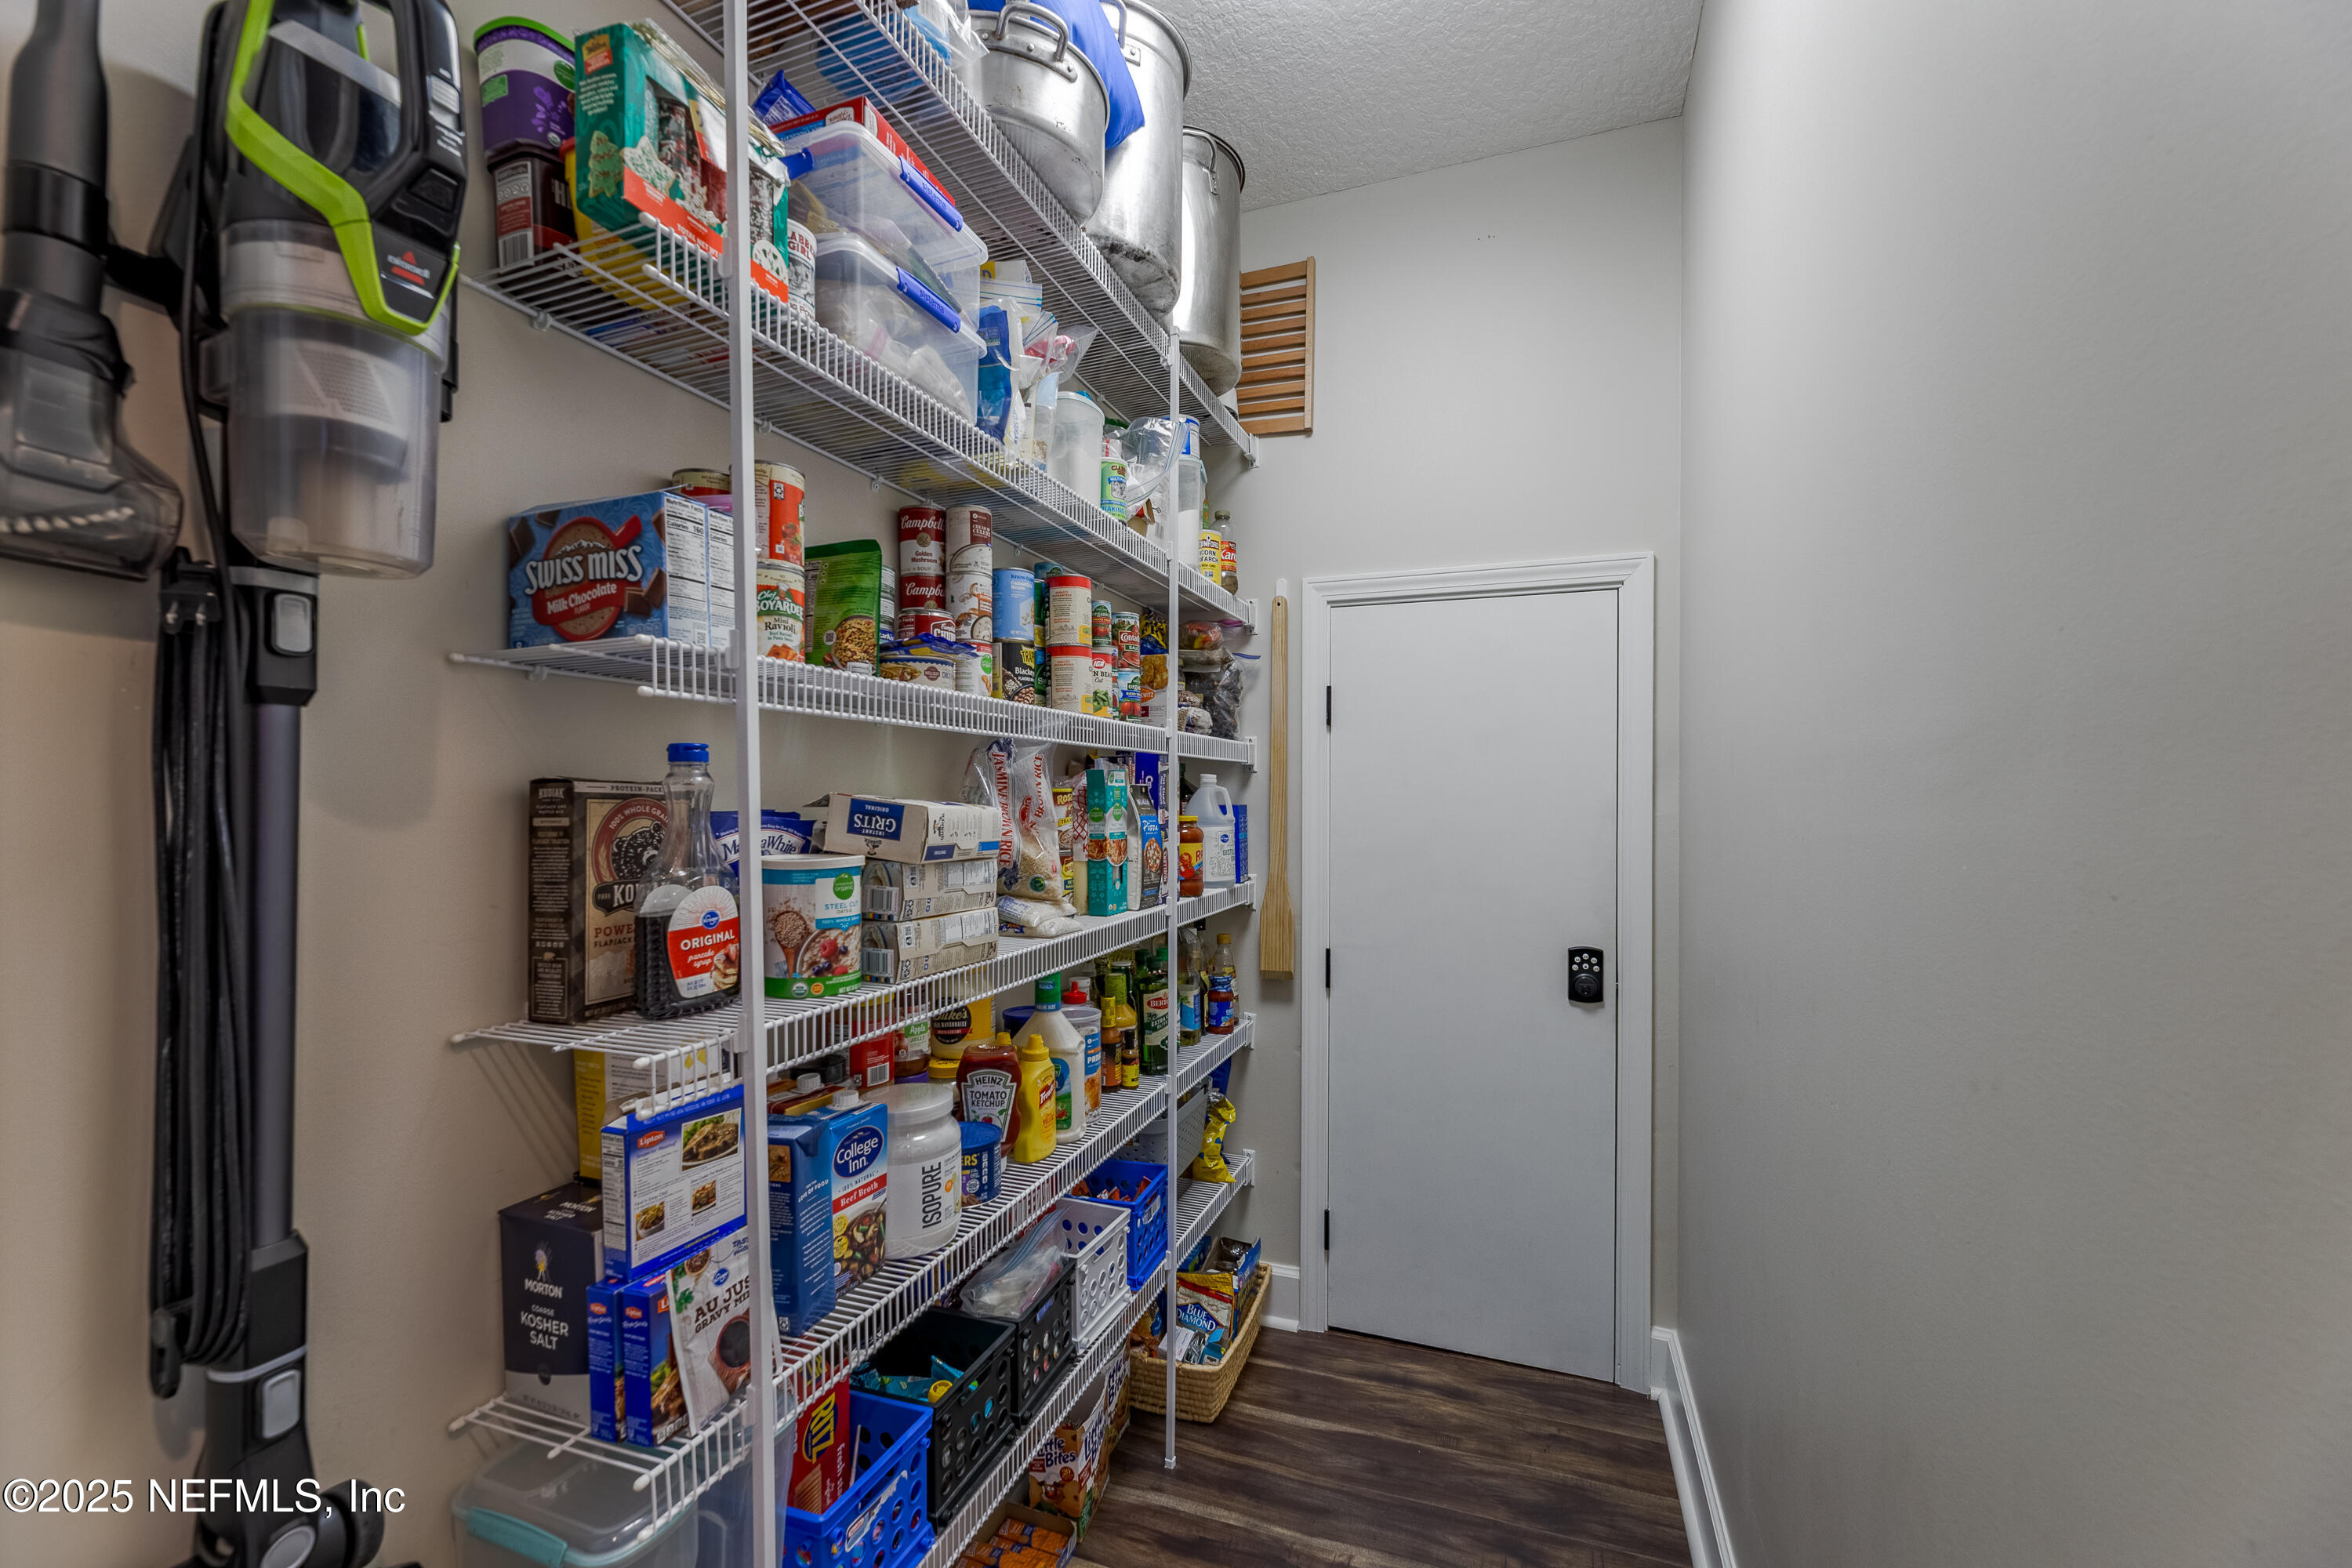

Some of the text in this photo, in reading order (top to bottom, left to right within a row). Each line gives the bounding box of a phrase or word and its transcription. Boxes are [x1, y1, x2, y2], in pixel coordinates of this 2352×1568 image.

[922, 182, 947, 211] sistema
[919, 289, 945, 314] sistema
[901, 515, 945, 532] Campbell
[1199, 540, 1219, 549] UMFORD
[524, 546, 643, 595] SWISS MISS
[757, 590, 777, 601] Chef
[906, 582, 946, 598] Campbe
[547, 583, 617, 615] Milk Chocolate
[764, 620, 797, 635] Ravioli
[991, 751, 1008, 800] JASMINE
[539, 788, 565, 799] KODIAK
[611, 785, 662, 793] PROTEIN-PACK
[623, 805, 651, 816] WHOLE
[865, 804, 889, 813] ORIGINAL
[854, 813, 896, 832] GRITS
[999, 802, 1013, 837] BROWN
[998, 840, 1014, 868] RICE
[825, 902, 848, 910] STEEL
[594, 924, 633, 938] POWE
[681, 929, 735, 951] ORIGINAL
[688, 949, 715, 964] pancake
[693, 959, 712, 969] syrup
[910, 1024, 926, 1035] Apple
[975, 1076, 1004, 1086] HEINZ
[970, 1090, 1007, 1099] TOMATO
[971, 1099, 1005, 1108] KETCHUP
[639, 1133, 664, 1146] Lipton
[836, 1136, 879, 1164] College
[855, 1171, 876, 1186] NATURAL
[840, 1181, 879, 1207] Beef Broth
[921, 1161, 942, 1229] ISOPURE
[560, 1201, 596, 1214] MORTON
[524, 1278, 564, 1298] MORTON
[531, 1304, 555, 1316] COARSE
[695, 1296, 719, 1324] AU
[1187, 1304, 1208, 1321] BLUE
[521, 1311, 569, 1337] KOSHER
[695, 1304, 731, 1334] GRAVY
[1176, 1308, 1216, 1331] DIAMOND
[529, 1331, 559, 1351] SALT
[811, 1392, 836, 1465] RITZ
[837, 1443, 846, 1472] fresh
[1045, 1450, 1076, 1468] Bites
